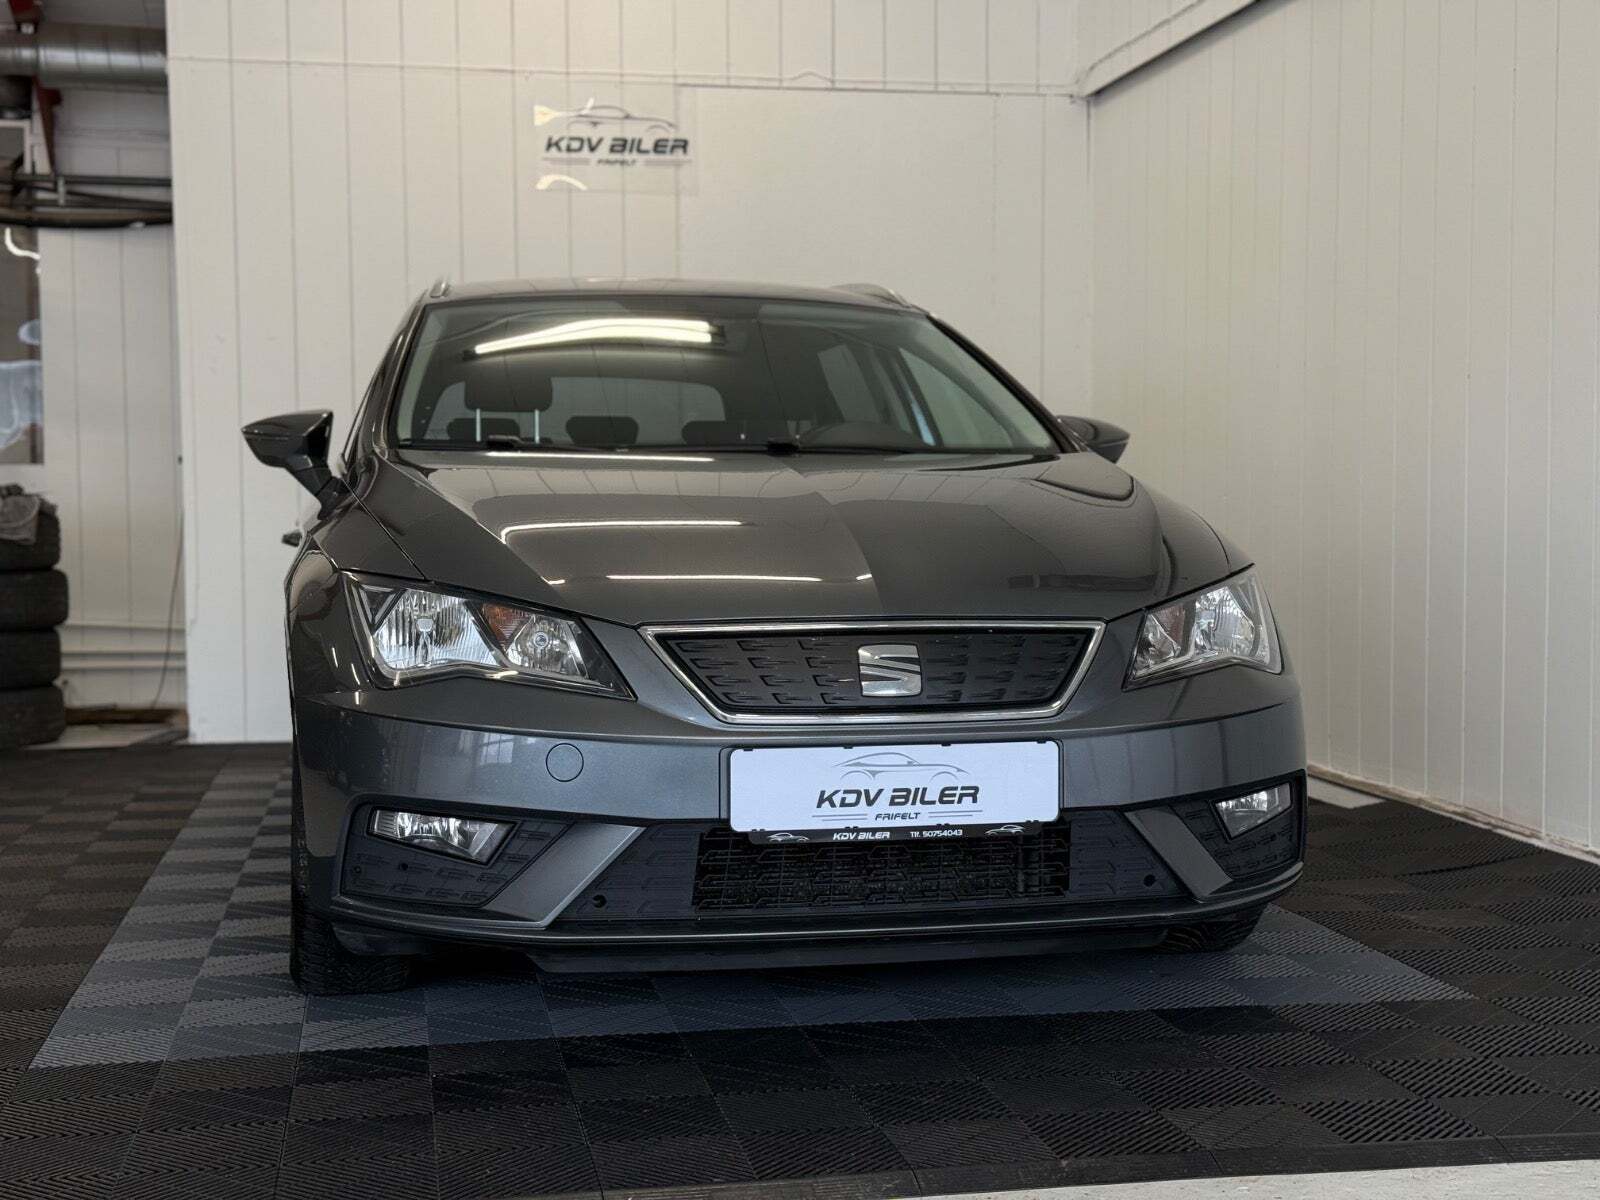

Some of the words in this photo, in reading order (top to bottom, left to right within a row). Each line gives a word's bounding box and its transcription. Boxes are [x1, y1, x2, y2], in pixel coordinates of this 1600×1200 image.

[545, 136, 604, 154] KDV
[609, 137, 690, 156] BILER
[816, 787, 885, 809] KDV
[888, 785, 980, 807] BILER
[874, 812, 922, 822] FRIFELT
[832, 831, 858, 841] KDV
[857, 831, 891, 841] BILER
[922, 829, 963, 838] 50754043
